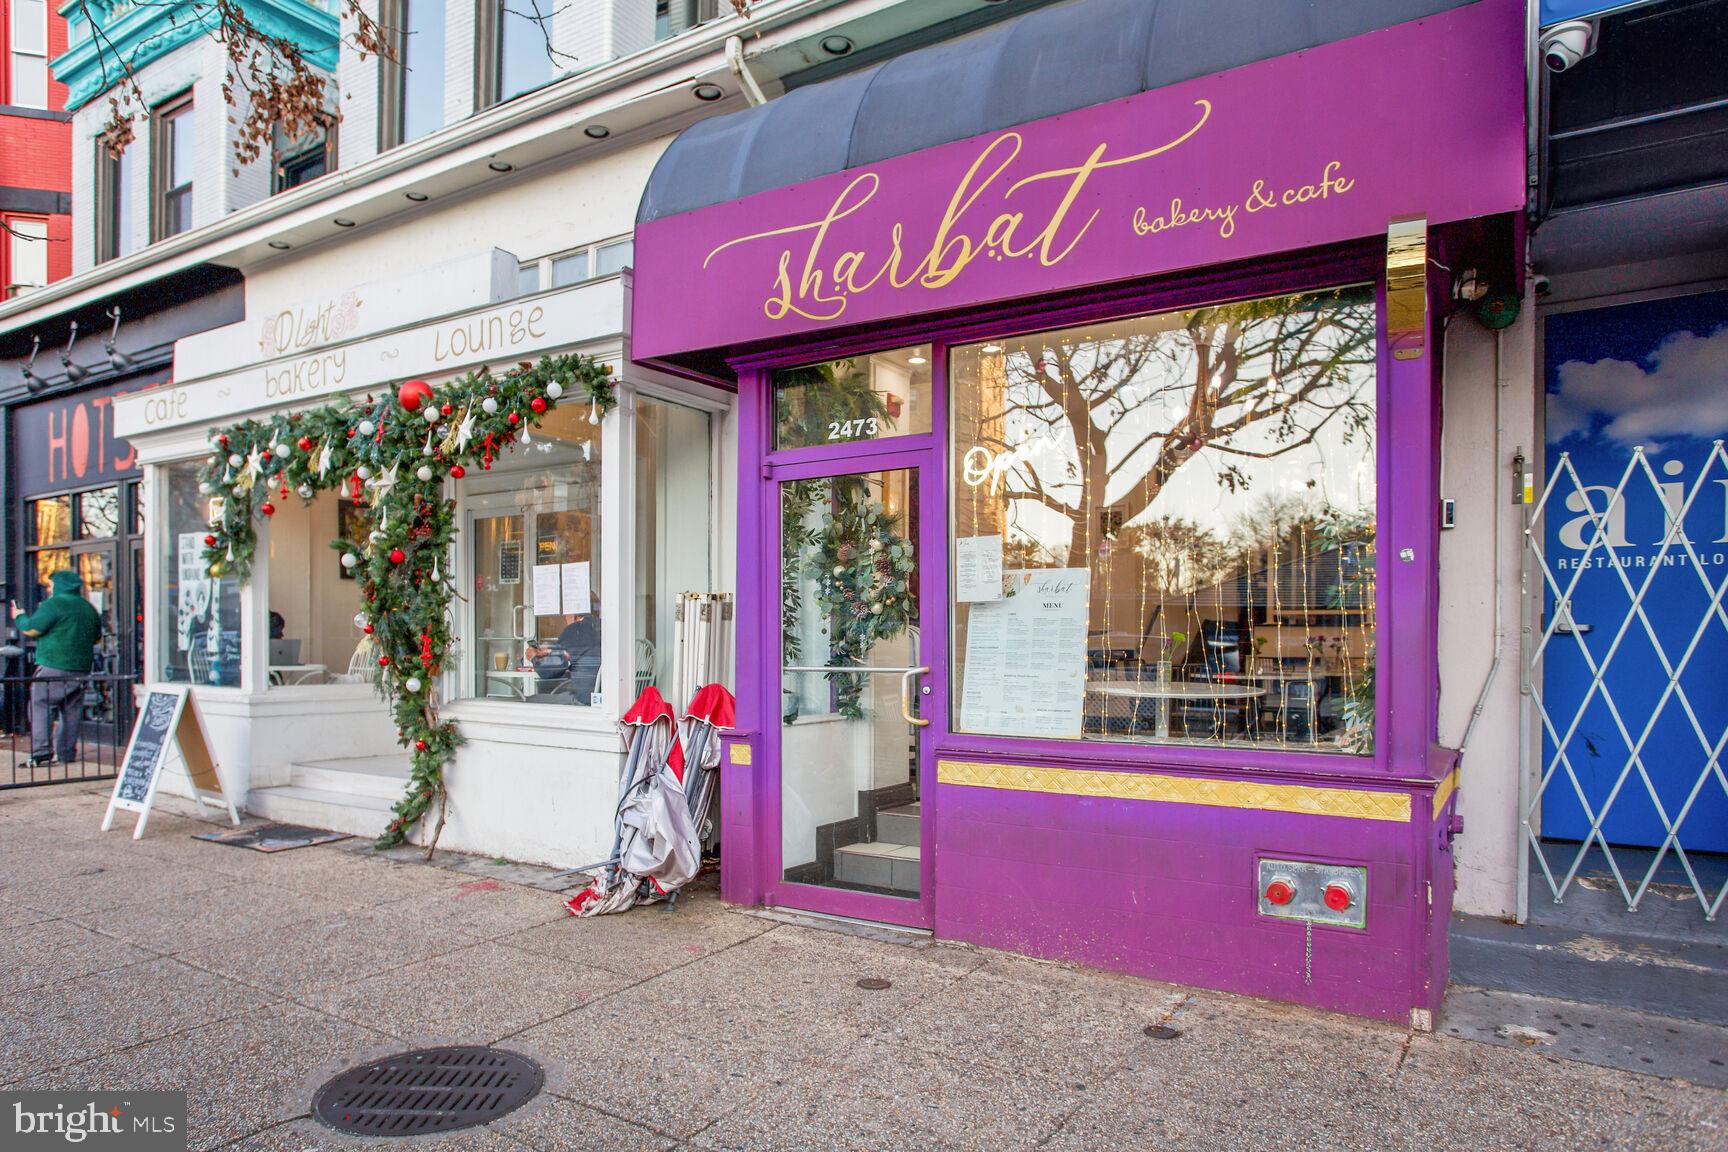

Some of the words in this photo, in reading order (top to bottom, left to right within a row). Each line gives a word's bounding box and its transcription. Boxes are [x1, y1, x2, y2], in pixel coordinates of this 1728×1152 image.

[703, 99, 1211, 320] sharbat
[1133, 198, 1238, 238] bakery
[1245, 179, 1277, 212] &
[1282, 161, 1355, 204] cafe
[144, 388, 188, 425] cafe
[265, 351, 346, 399] bakery
[828, 417, 878, 440] 2473
